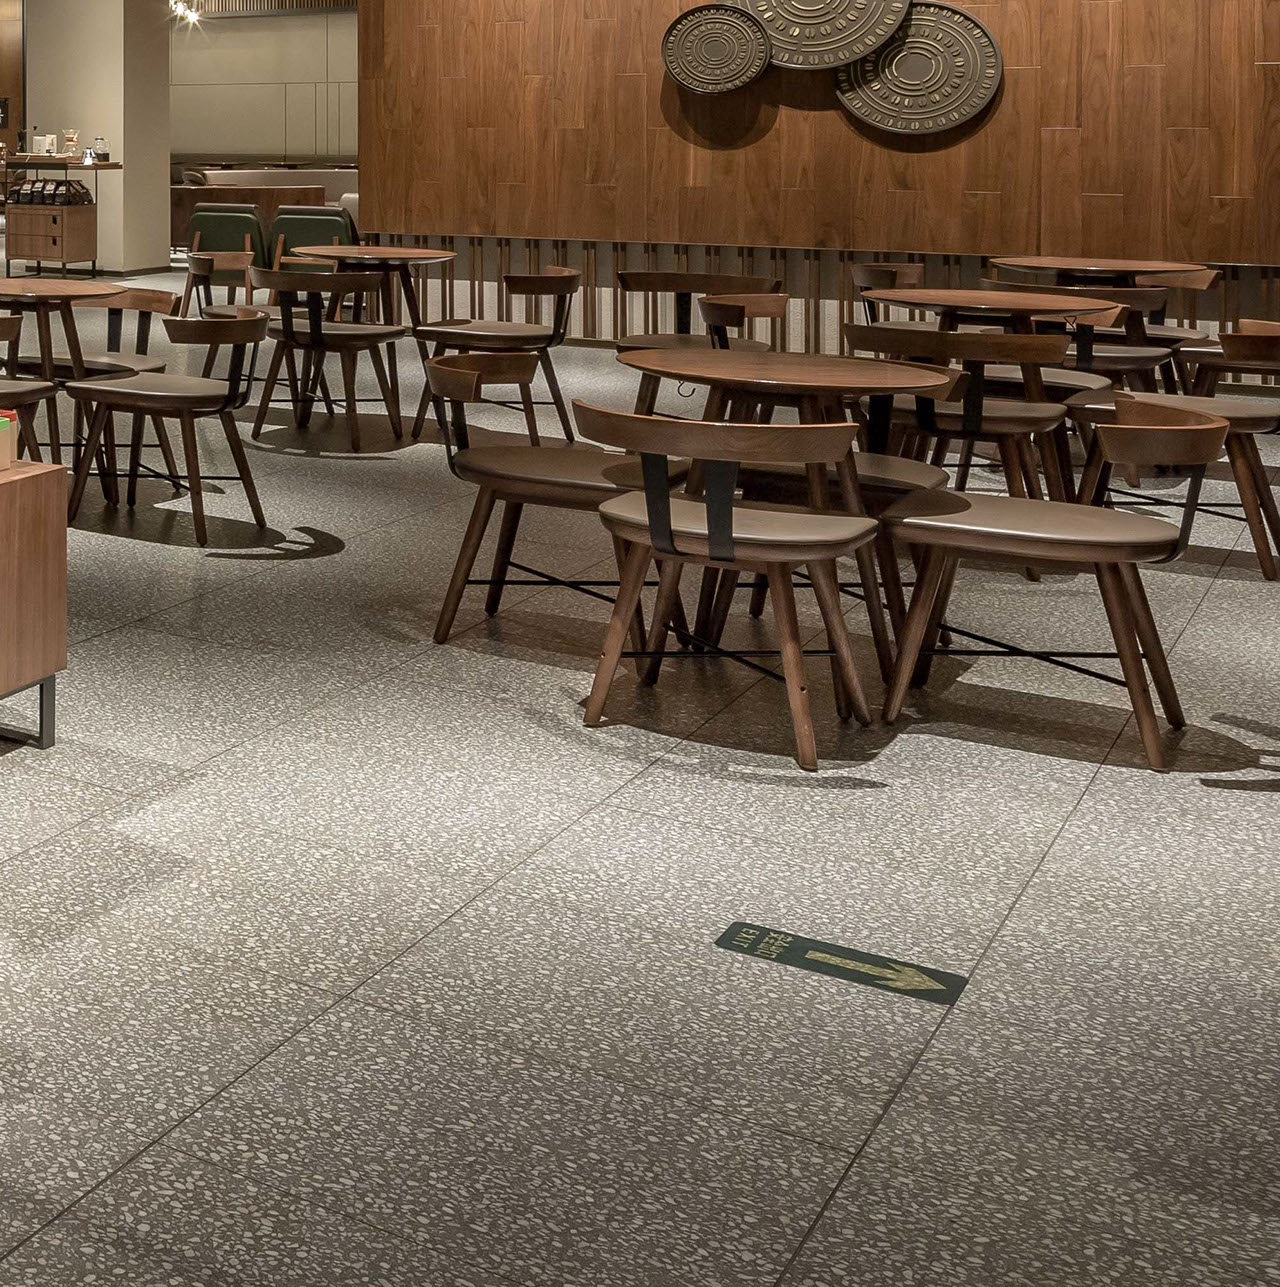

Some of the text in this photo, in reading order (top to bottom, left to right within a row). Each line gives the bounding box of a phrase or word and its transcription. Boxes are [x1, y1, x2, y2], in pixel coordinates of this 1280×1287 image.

[731, 928, 760, 948] EXIT
[754, 932, 794, 959] 安全出口
